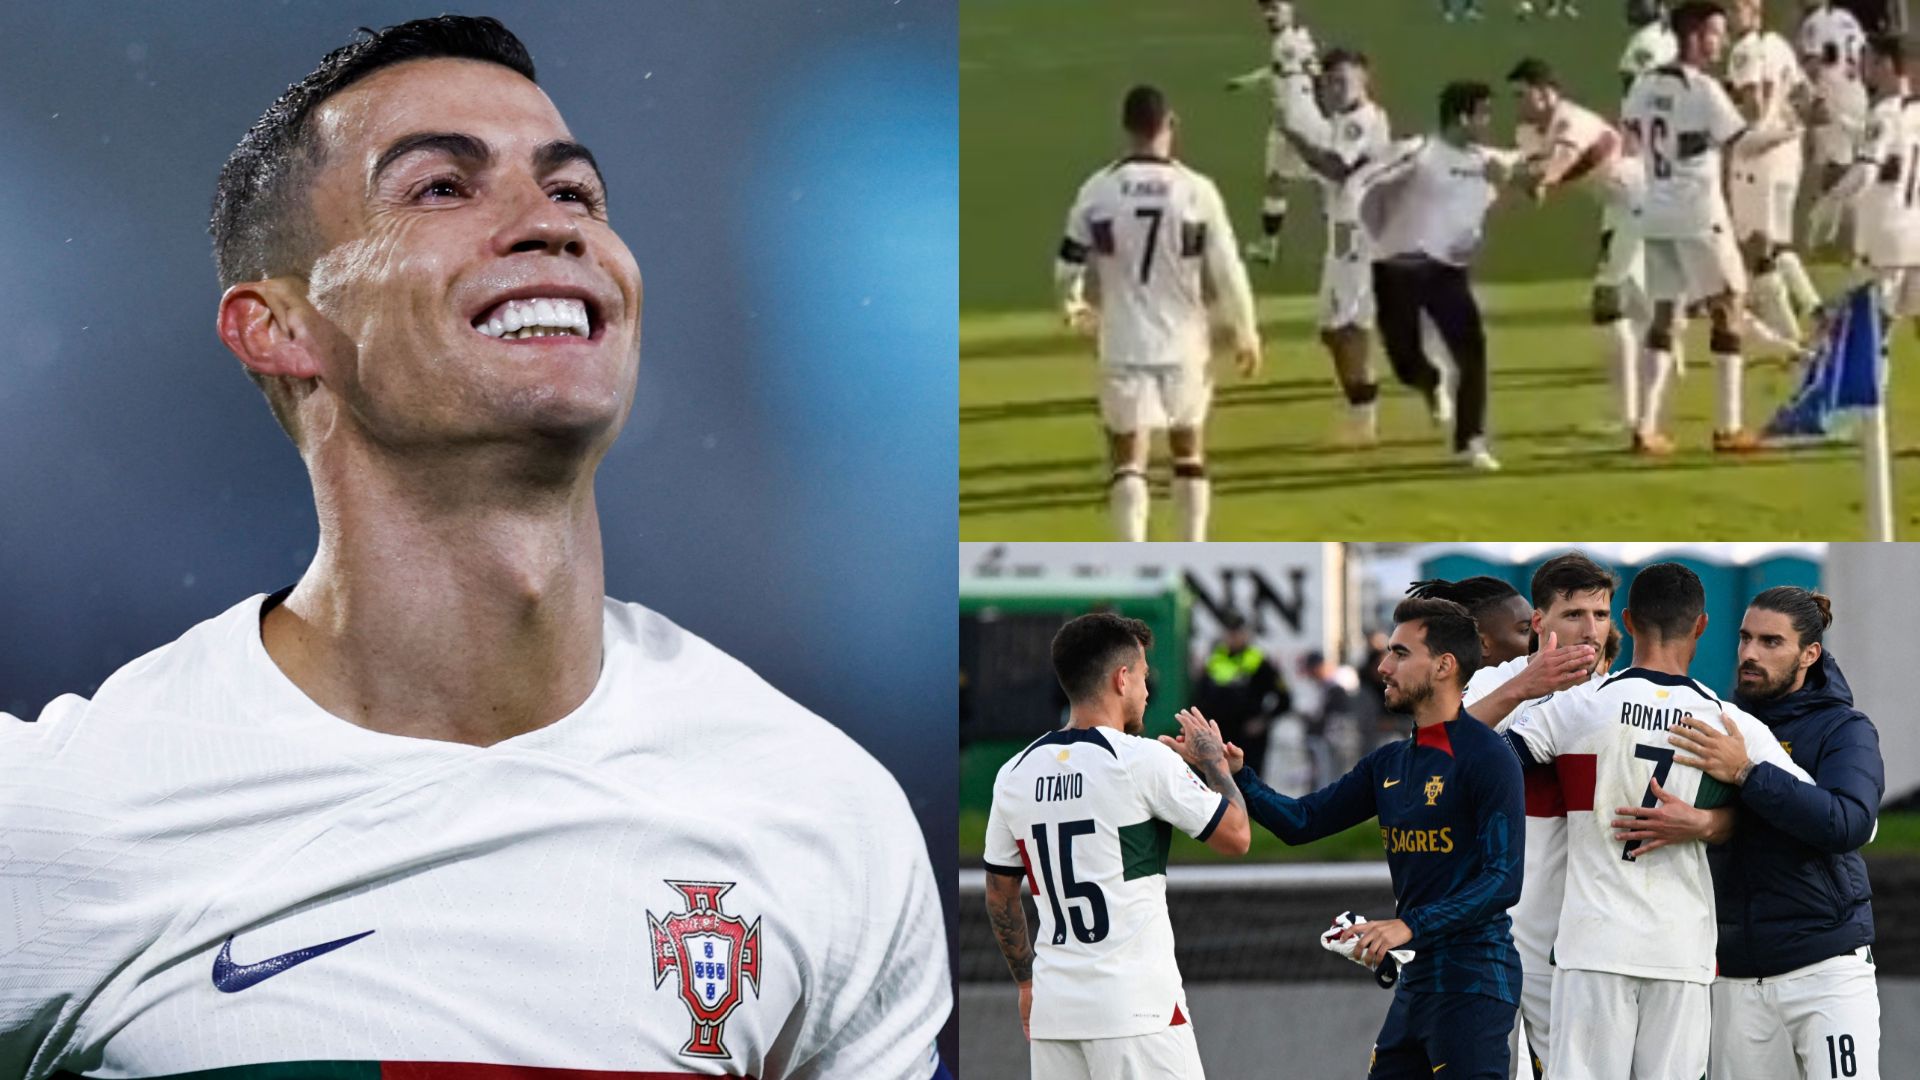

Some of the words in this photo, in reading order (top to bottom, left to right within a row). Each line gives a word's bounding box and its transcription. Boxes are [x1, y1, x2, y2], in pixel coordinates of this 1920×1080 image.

[1135, 208, 1162, 285] 7
[1035, 772, 1083, 802] OTÁVIO
[1622, 743, 1675, 862] 7
[1391, 826, 1454, 853] SAGRES
[1031, 819, 1110, 945] 15
[1826, 1033, 1857, 1079] 18
